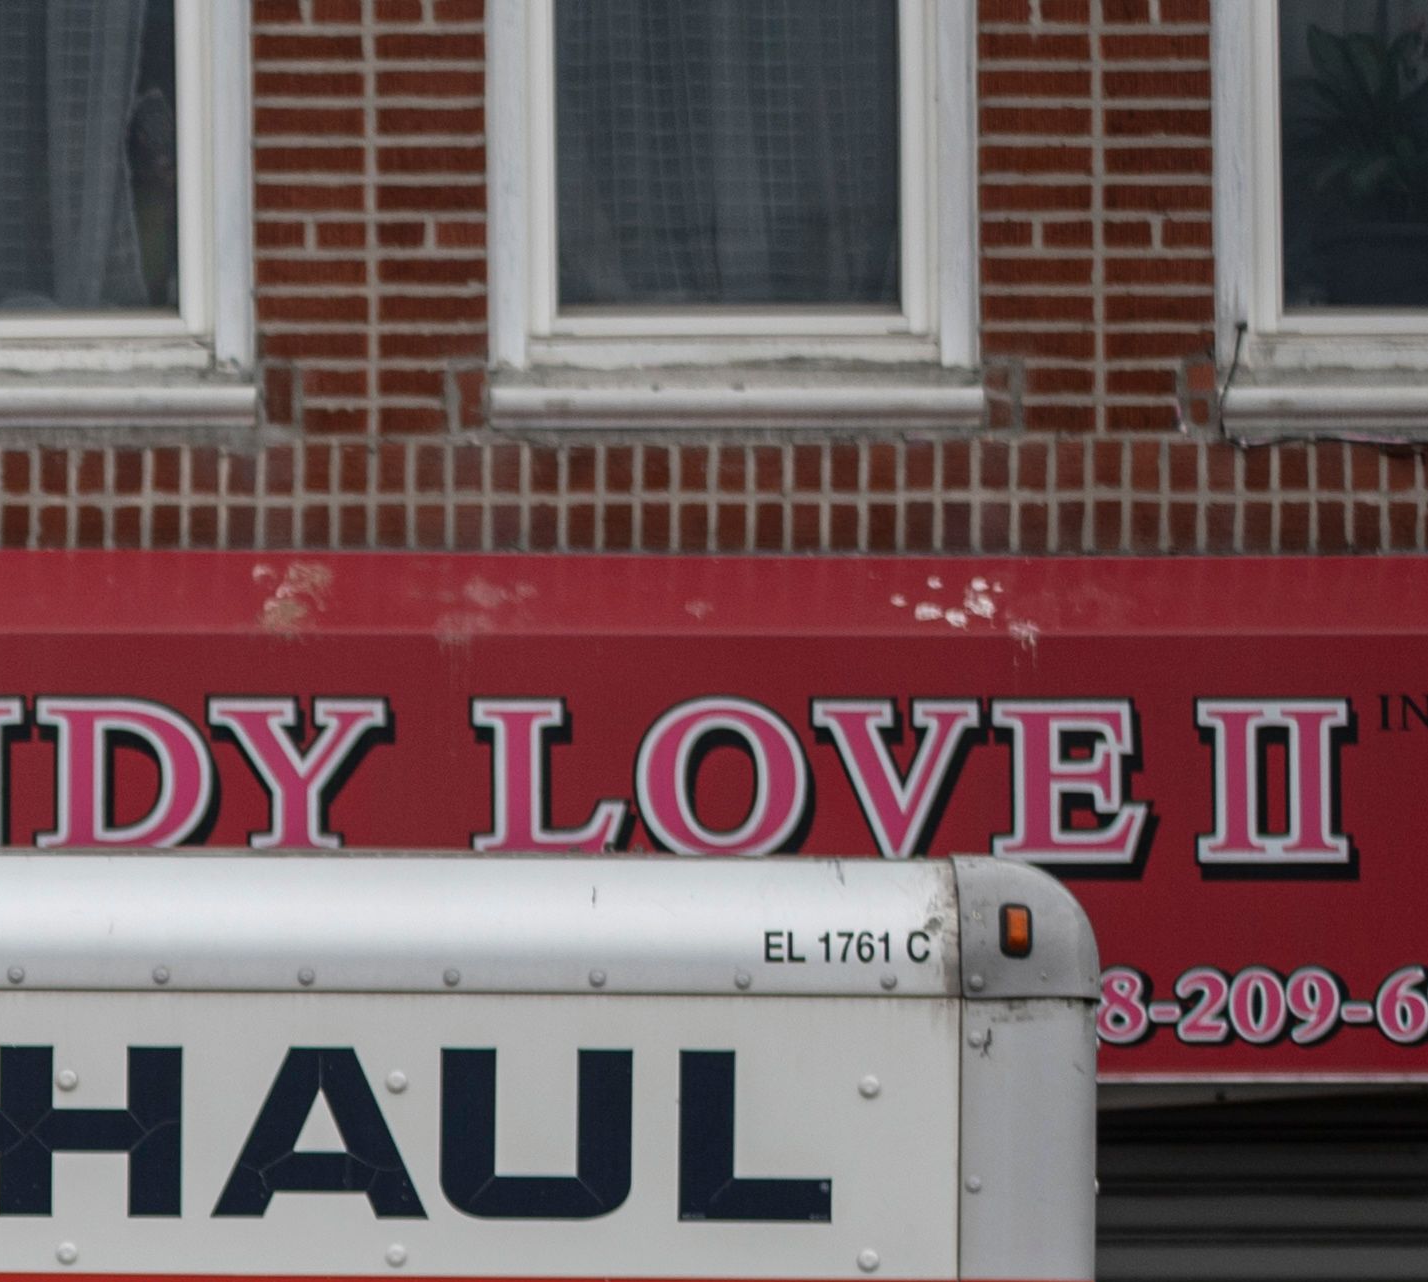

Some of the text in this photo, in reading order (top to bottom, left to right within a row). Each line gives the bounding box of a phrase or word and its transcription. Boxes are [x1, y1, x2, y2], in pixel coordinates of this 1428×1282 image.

[471, 696, 1153, 870] LOVE
[763, 931, 932, 965] EL 1761 C
